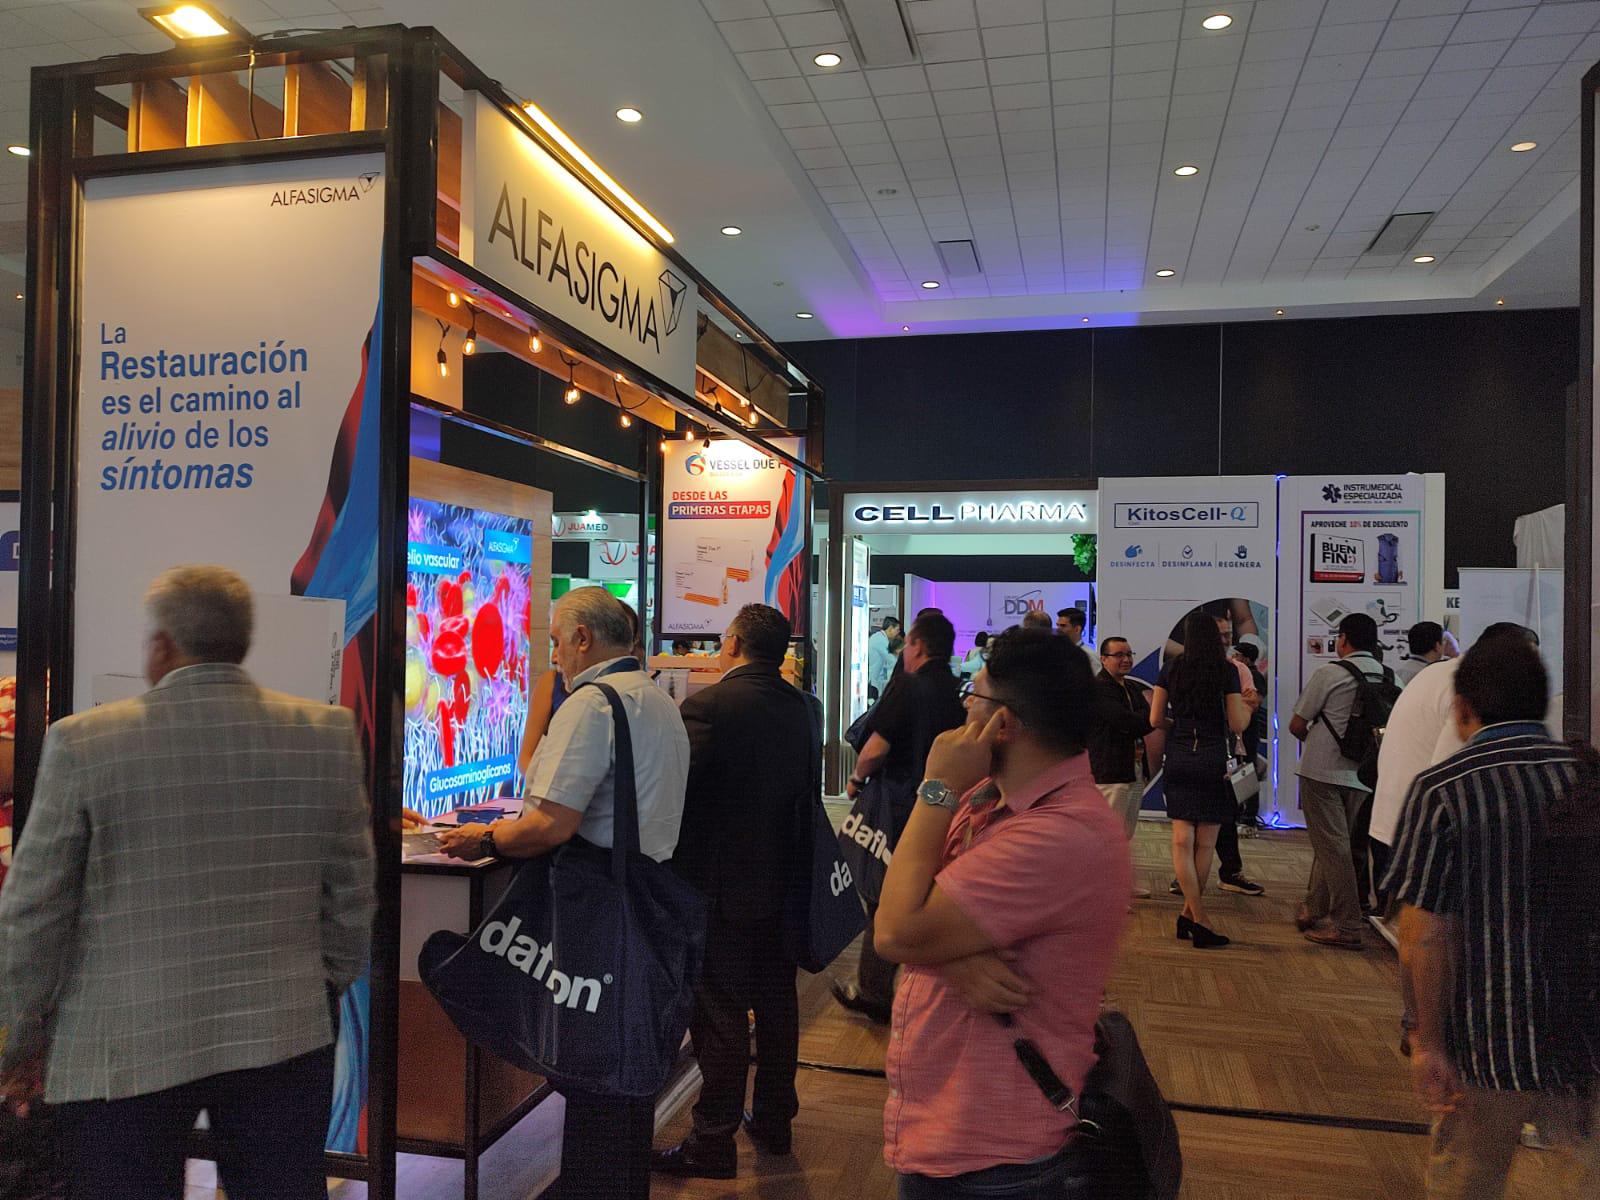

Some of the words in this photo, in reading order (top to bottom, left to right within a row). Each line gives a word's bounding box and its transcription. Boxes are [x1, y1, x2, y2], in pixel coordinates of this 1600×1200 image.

[271, 186, 360, 207] ALFASIGMA
[487, 181, 660, 354] ALFASIGMA
[101, 322, 126, 344] La
[100, 340, 308, 380] Restauración
[101, 393, 131, 415] es
[139, 386, 161, 413] el
[169, 384, 269, 412] camino
[277, 381, 301, 408] al
[101, 421, 176, 450] alivio
[185, 420, 219, 449] de
[228, 419, 269, 447] los
[709, 459, 750, 470] VESSEL
[753, 458, 775, 469] DUE
[100, 456, 254, 490] síntomas
[672, 491, 706, 501] DESDE
[709, 491, 728, 500] LAS
[1343, 492, 1402, 500] ESPECIALIZADA
[672, 505, 726, 515] PRIMERAS
[729, 505, 769, 515] ETAPAS
[855, 506, 954, 521] CELL
[961, 505, 1084, 520] PHARMA
[568, 523, 608, 531] JUAMED
[1322, 542, 1356, 554] BUEN
[424, 553, 460, 569] vascular
[1004, 599, 1044, 614] DDM
[430, 763, 511, 793] Glucosaminoglicanos
